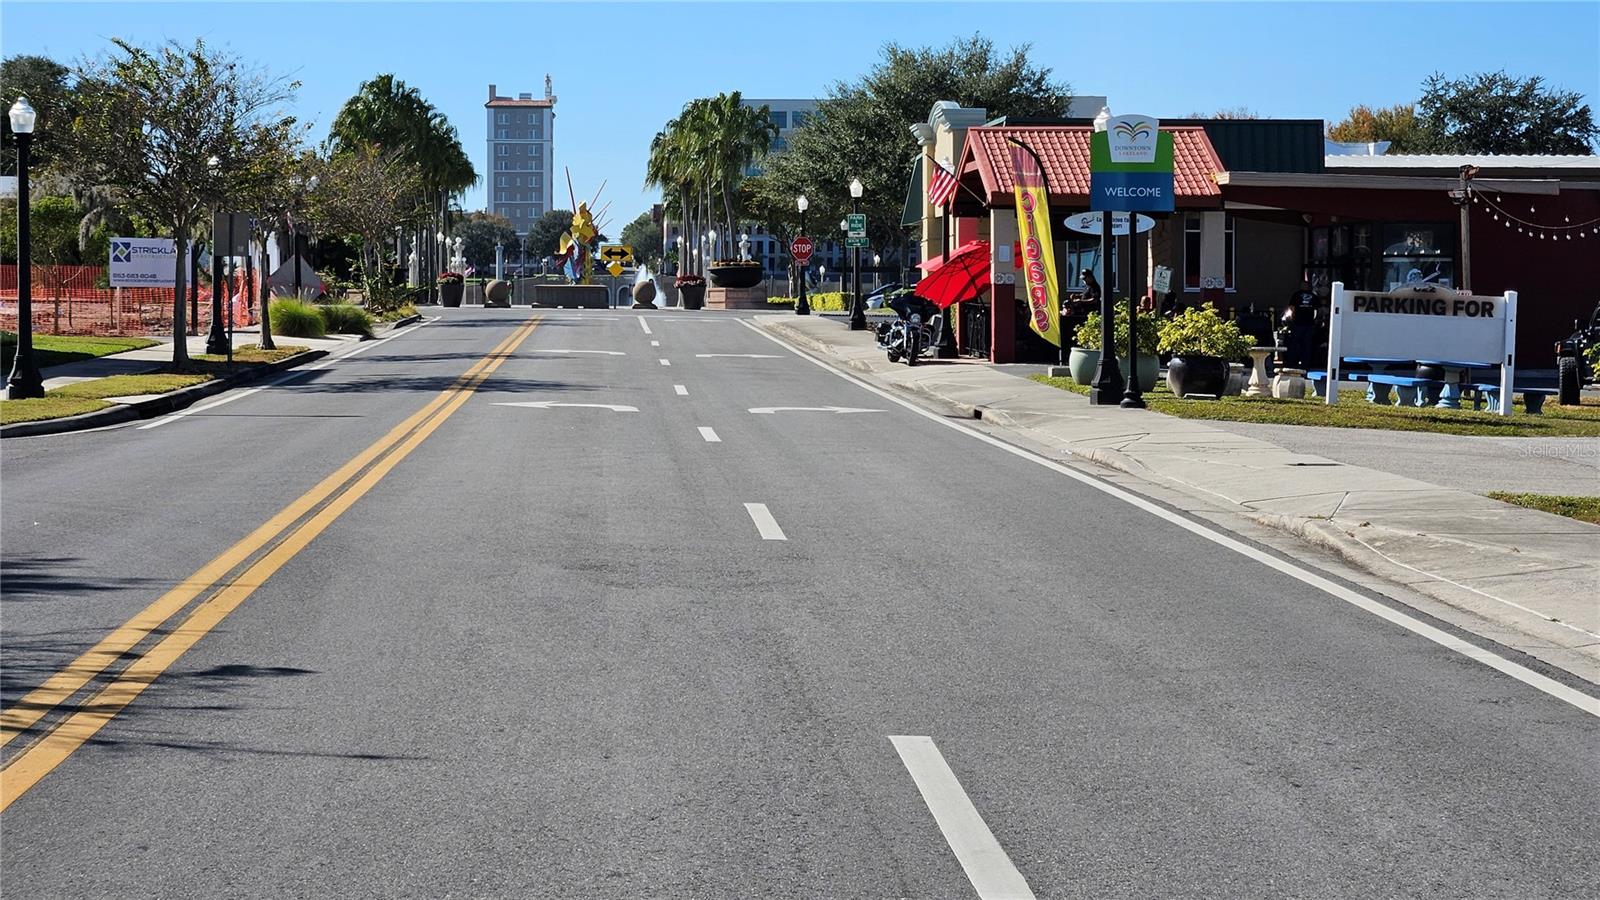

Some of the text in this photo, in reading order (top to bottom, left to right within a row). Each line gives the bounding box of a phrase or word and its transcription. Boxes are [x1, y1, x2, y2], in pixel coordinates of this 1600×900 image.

[1104, 187, 1161, 197] WELCOME
[793, 243, 812, 253] STOP
[1353, 296, 1495, 318] PARKING FOR
